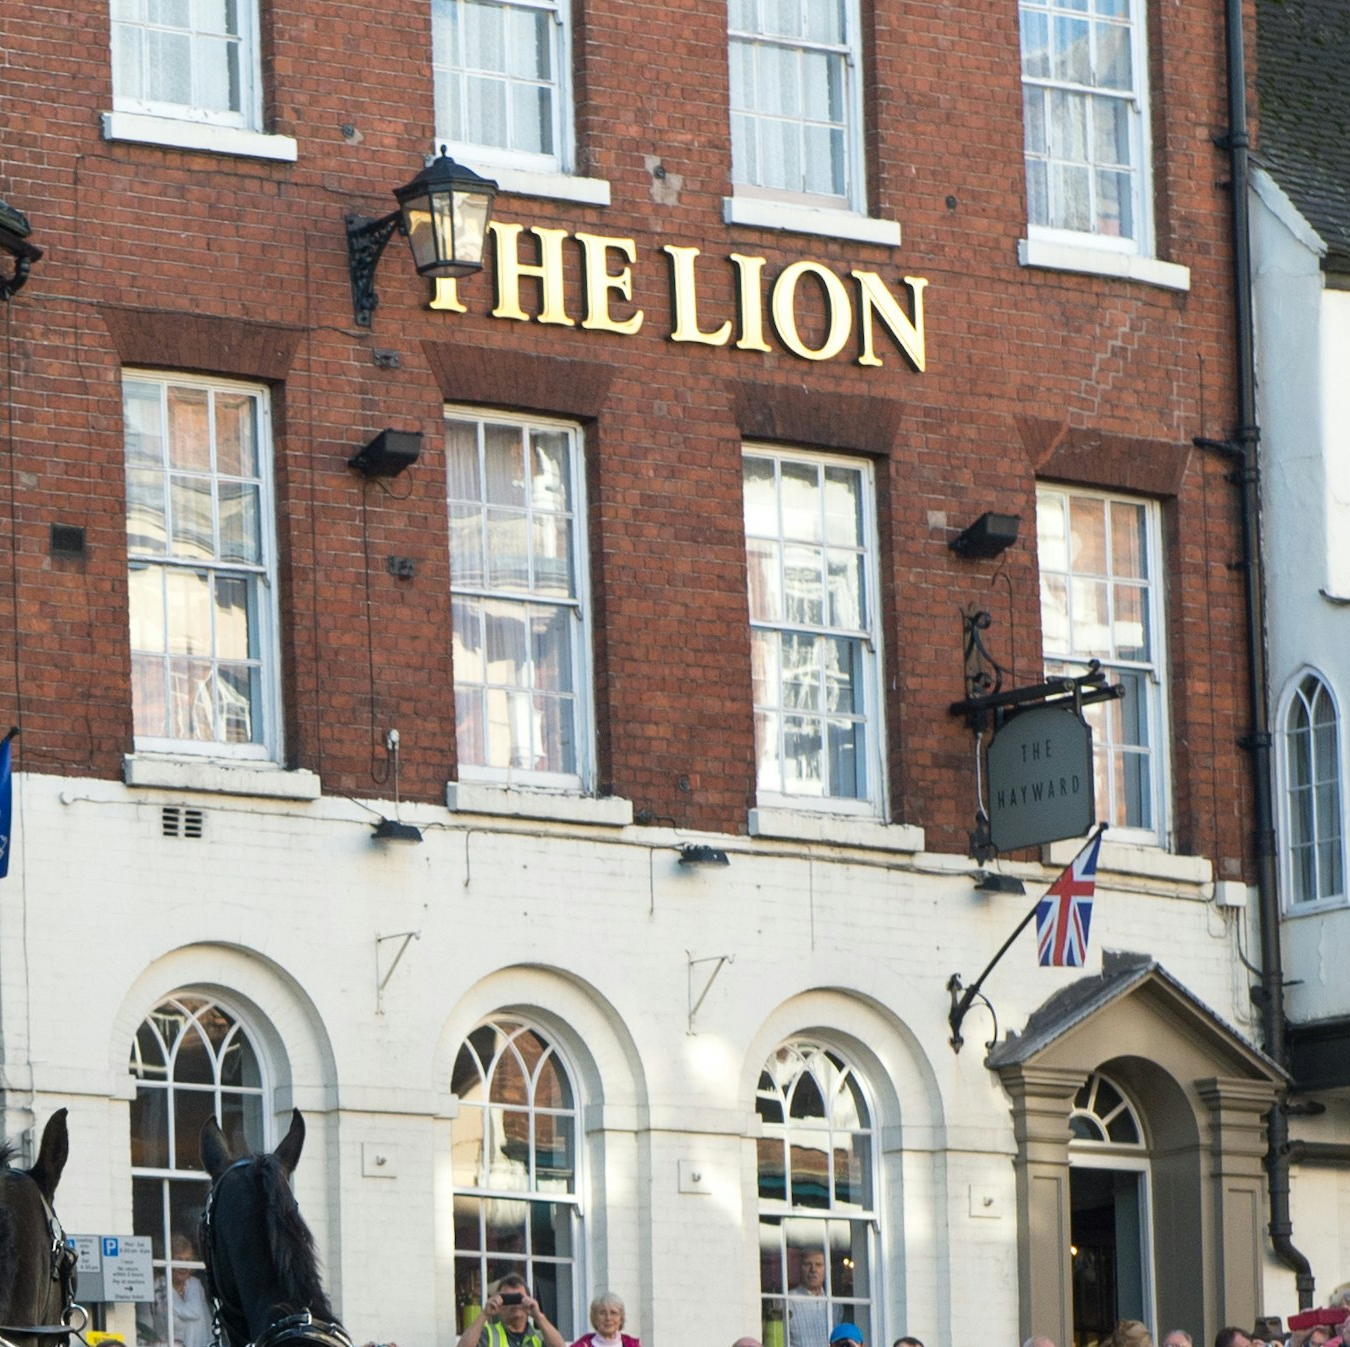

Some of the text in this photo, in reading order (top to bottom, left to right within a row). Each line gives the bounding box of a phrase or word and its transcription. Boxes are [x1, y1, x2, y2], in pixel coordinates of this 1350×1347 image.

[663, 244, 930, 374] LION
[997, 739, 1081, 811] THE HAYWARD
[105, 1239, 117, 1255] P
